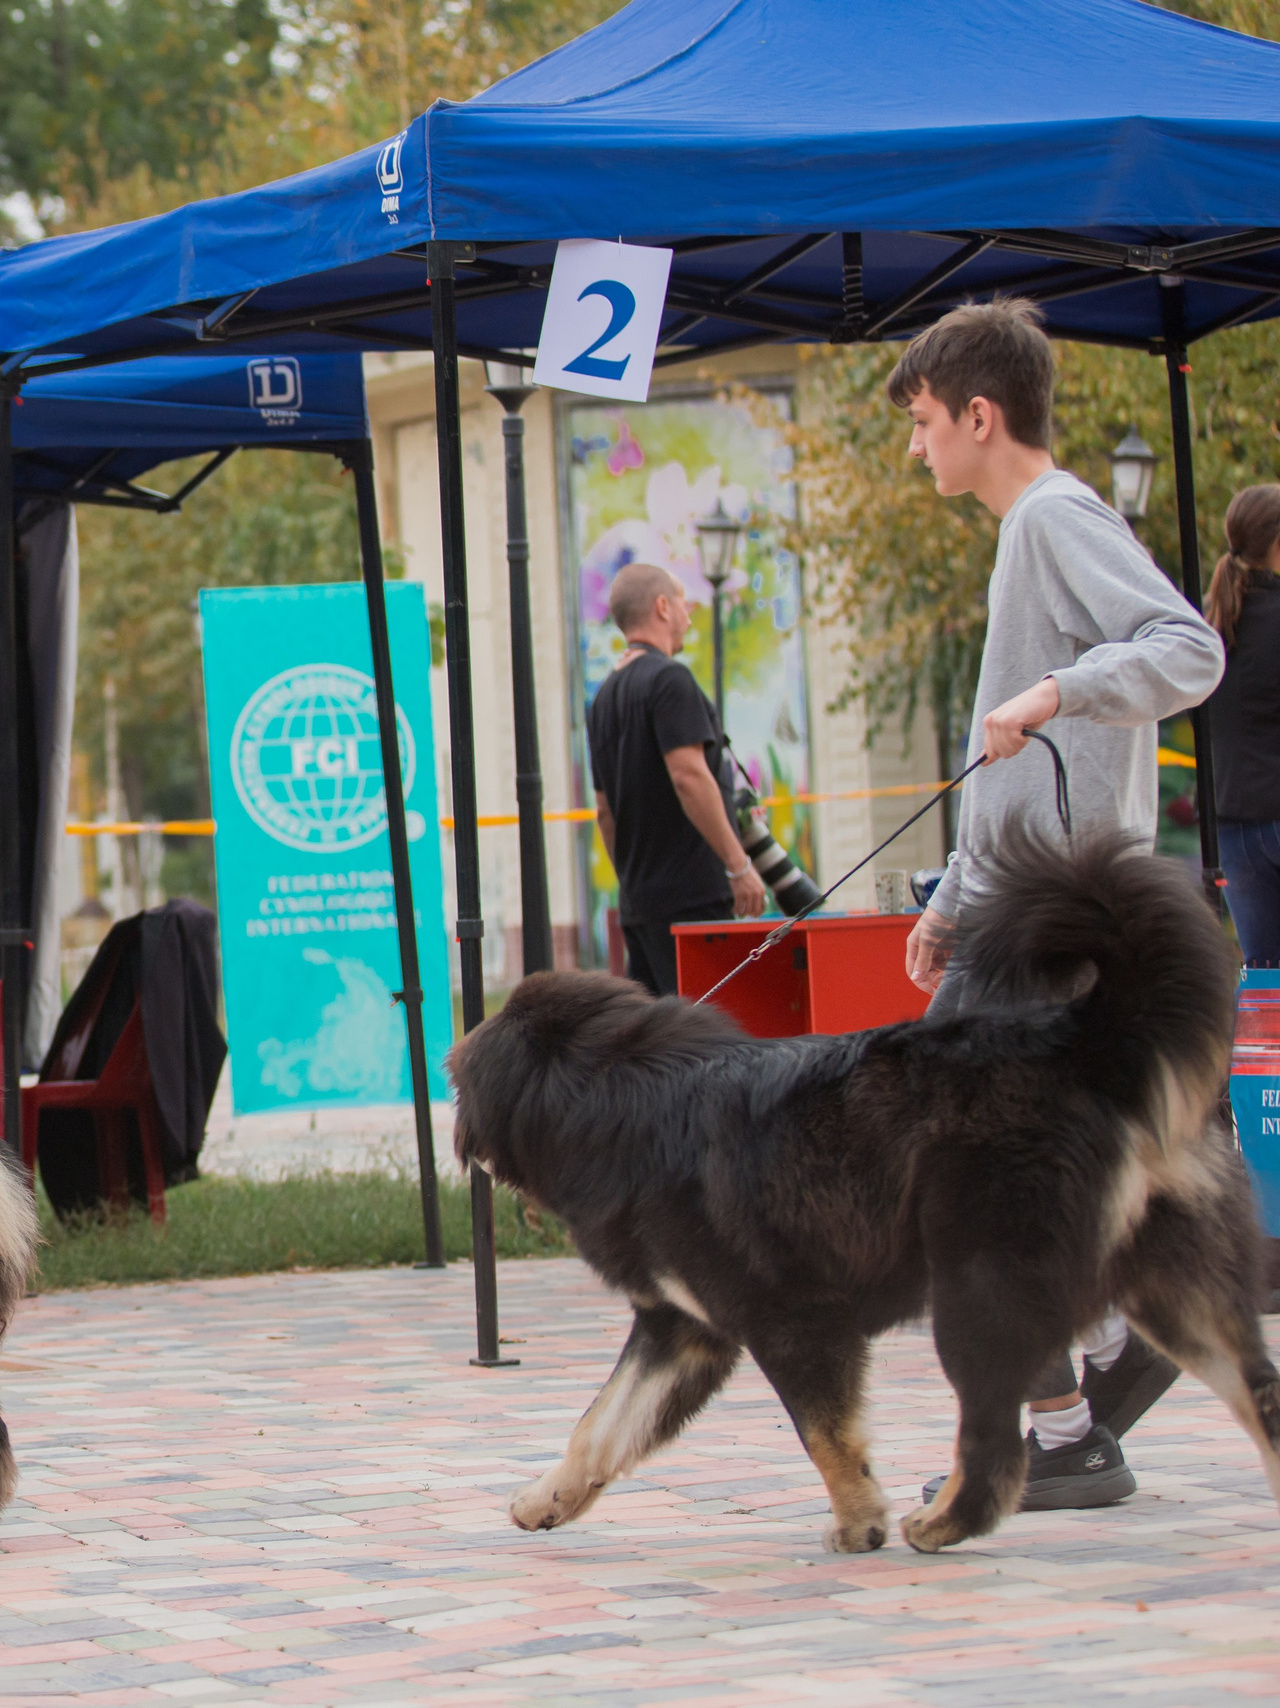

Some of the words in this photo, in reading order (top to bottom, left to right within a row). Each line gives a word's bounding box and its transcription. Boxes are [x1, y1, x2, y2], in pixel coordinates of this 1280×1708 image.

[381, 195, 400, 214] DIMA
[561, 279, 637, 381] 2
[291, 737, 359, 777] FCI
